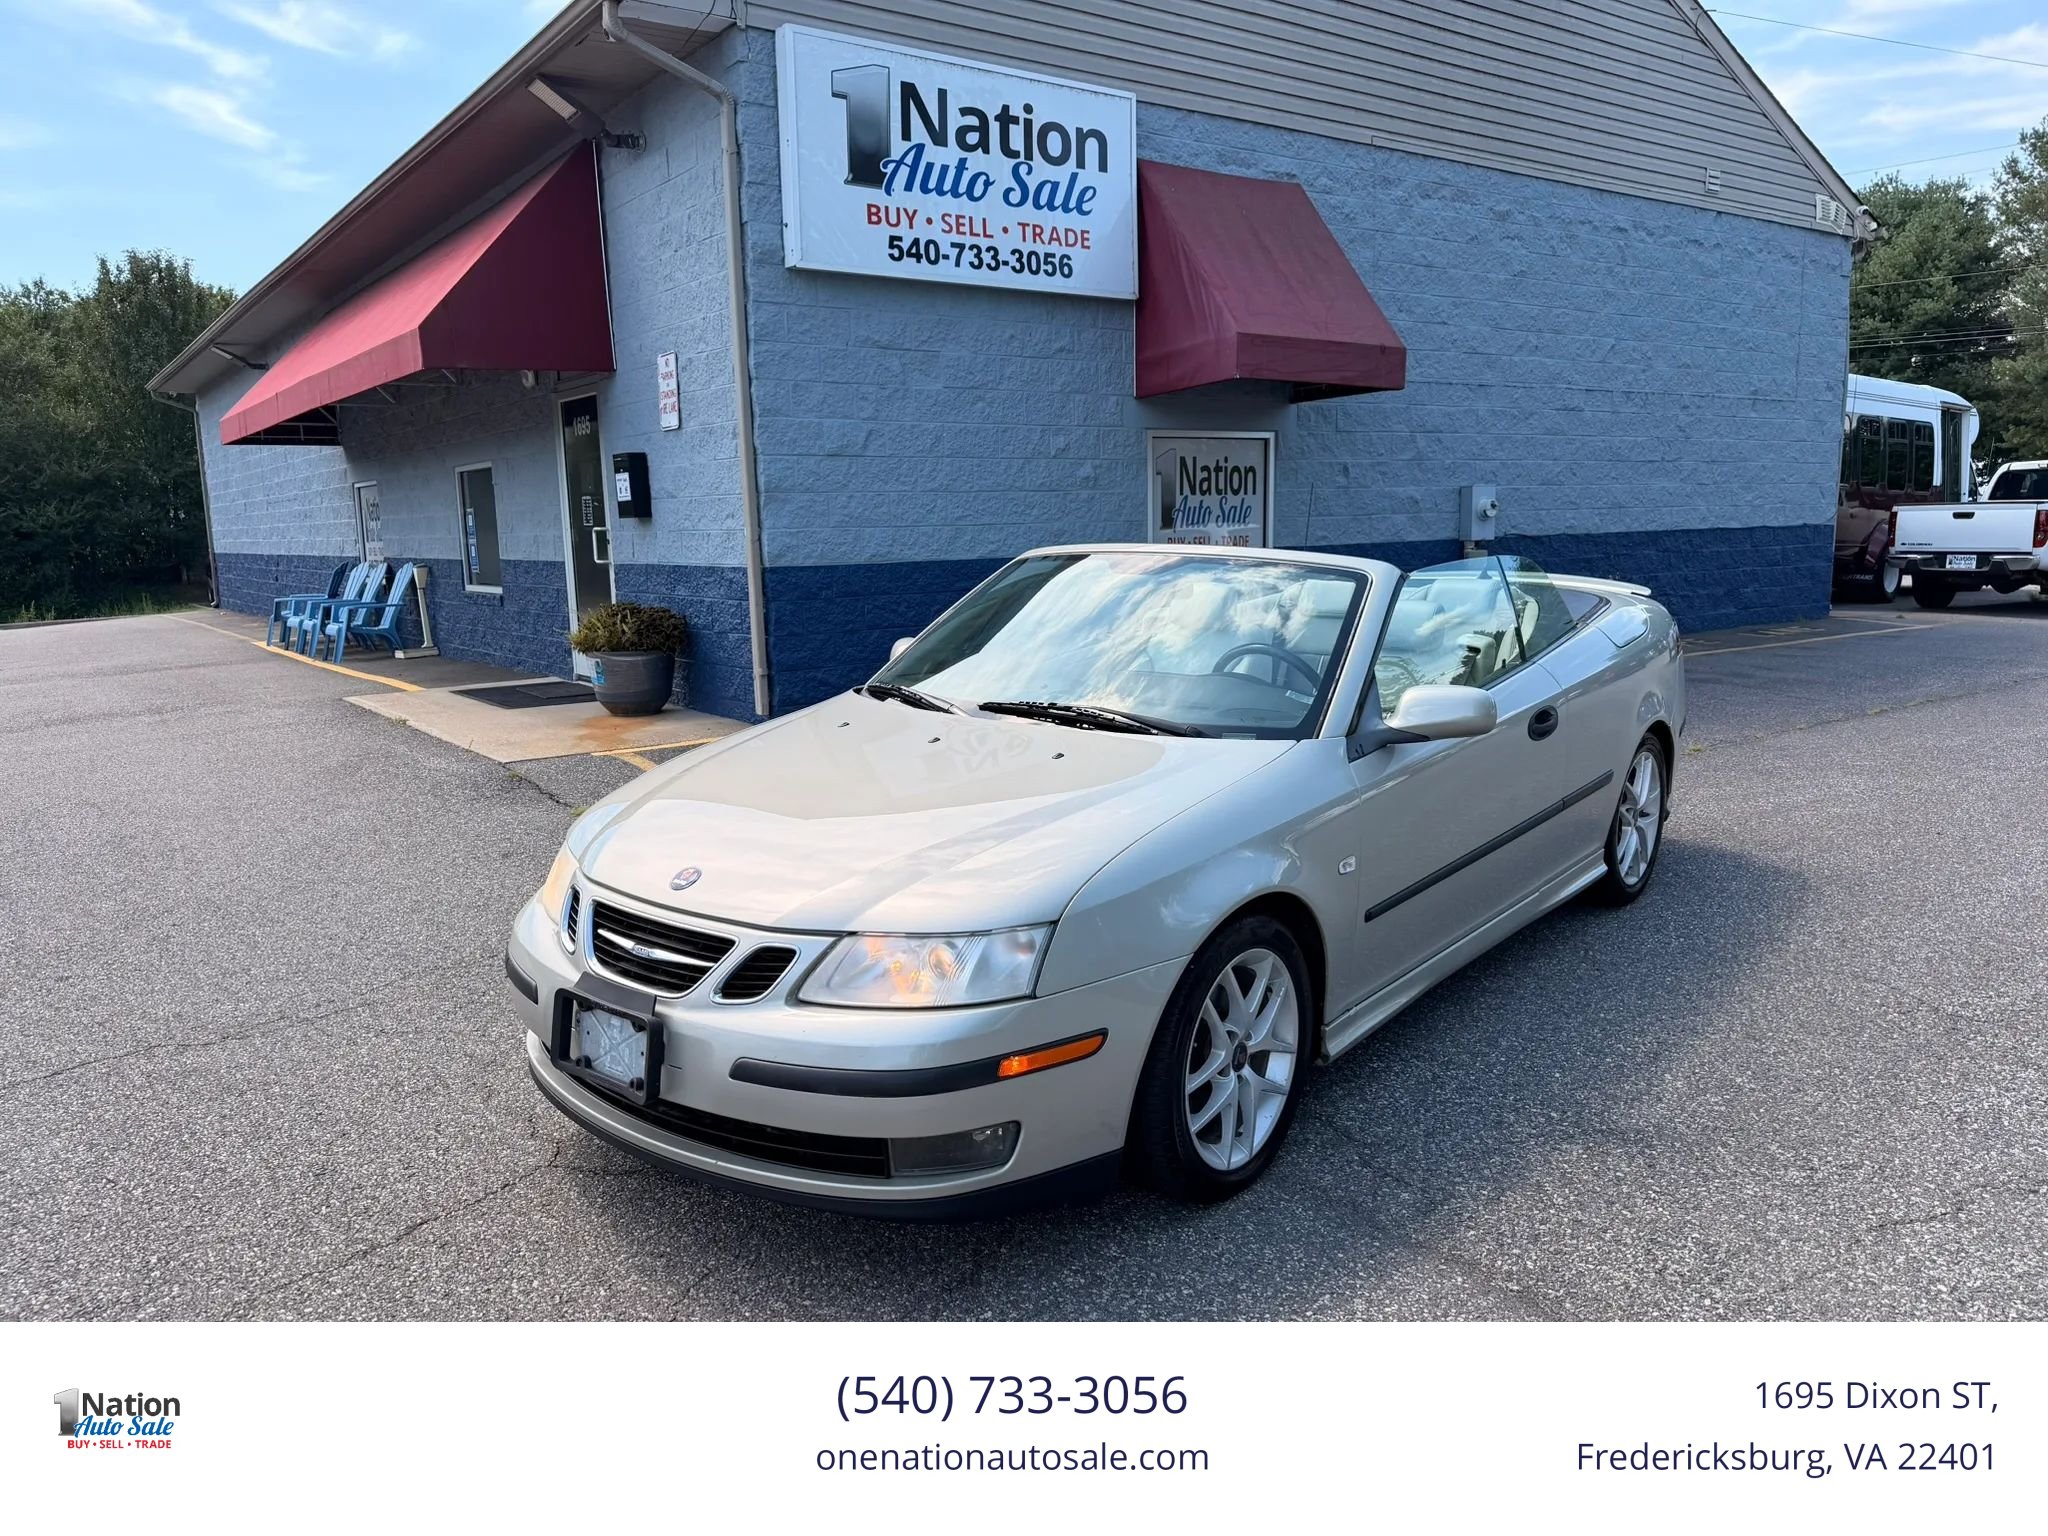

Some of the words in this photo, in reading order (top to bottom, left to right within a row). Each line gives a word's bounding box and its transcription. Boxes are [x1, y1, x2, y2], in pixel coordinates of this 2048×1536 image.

[831, 64, 892, 189] 1
[900, 80, 1109, 173] Nation
[880, 143, 996, 201] Auto
[1002, 161, 1097, 216] Sale
[866, 203, 918, 229] BUY
[941, 213, 994, 239] SELL
[1017, 222, 1091, 250] TRADE
[888, 235, 1073, 279] 540-733-3056
[573, 415, 591, 436] 1695
[1179, 455, 1257, 496] Nation
[1172, 495, 1213, 534] Auto
[1215, 495, 1252, 528] Sale
